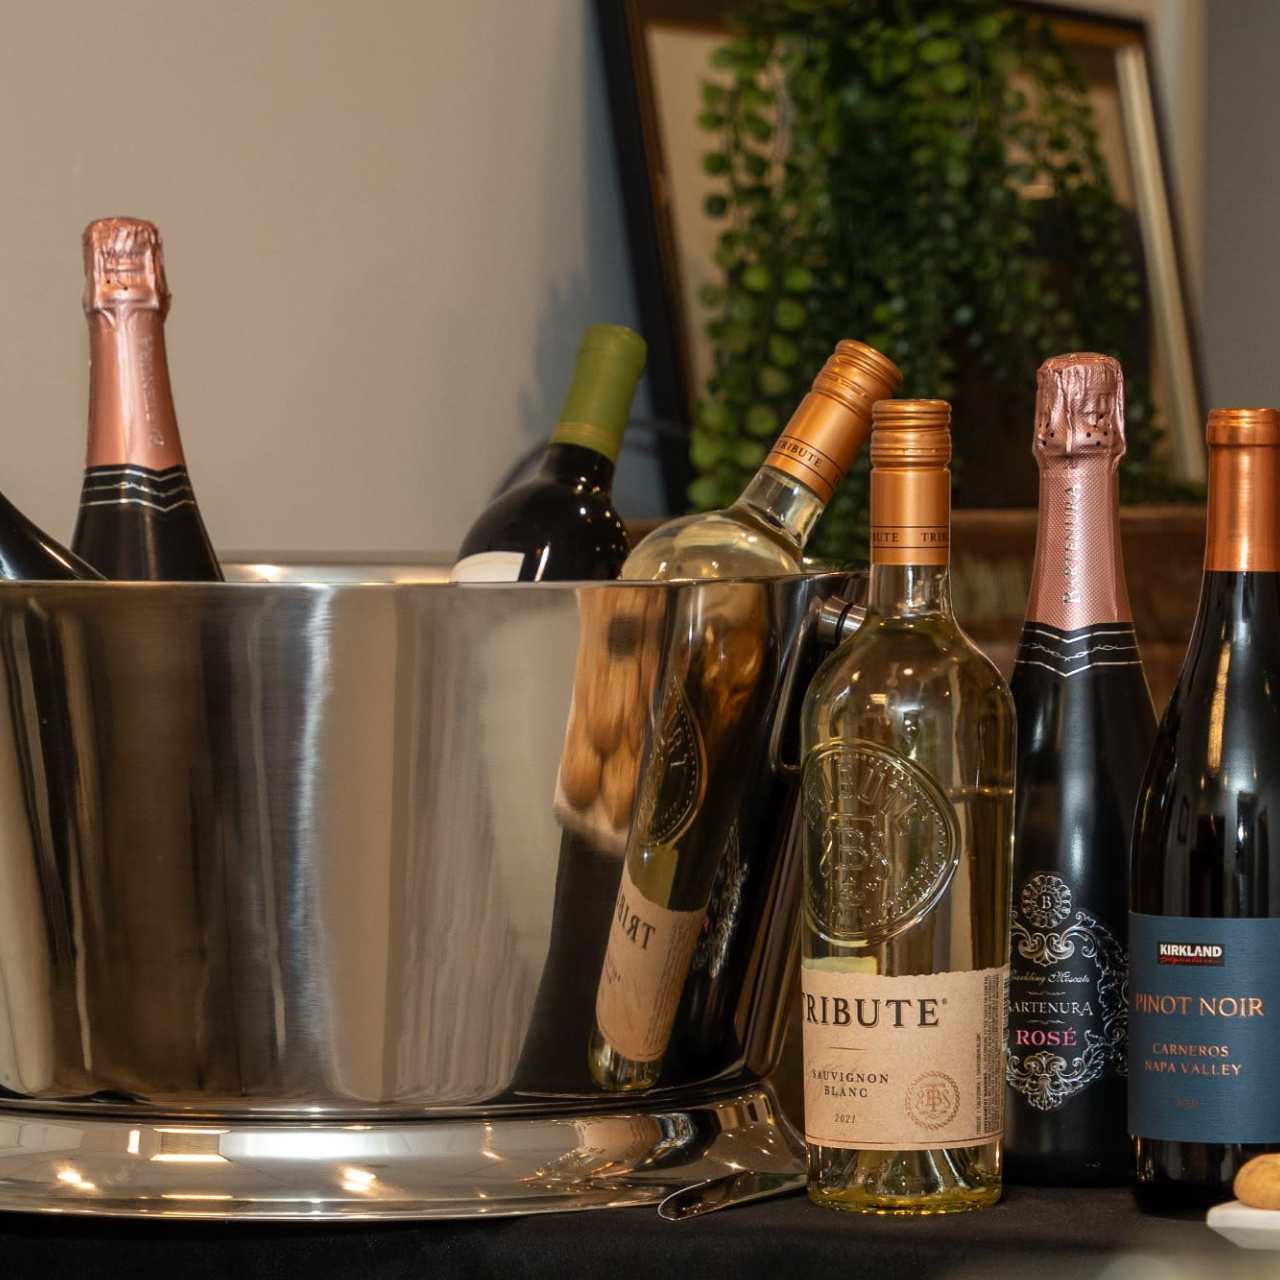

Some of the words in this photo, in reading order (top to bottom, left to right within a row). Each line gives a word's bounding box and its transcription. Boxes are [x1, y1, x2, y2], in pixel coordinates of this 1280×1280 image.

[1159, 943, 1224, 958] KIRKLAND
[800, 991, 940, 1028] RIBUTE
[1135, 992, 1193, 1016] PINOT
[1199, 995, 1265, 1018] NOIR
[1015, 1026, 1078, 1047] ROSÉ
[1151, 1043, 1230, 1058] CARNEROS
[811, 1068, 889, 1084] SAUVIGNON
[1144, 1059, 1176, 1074] NAPA
[1180, 1062, 1242, 1077] VALLEY
[823, 1085, 869, 1098] BLANC
